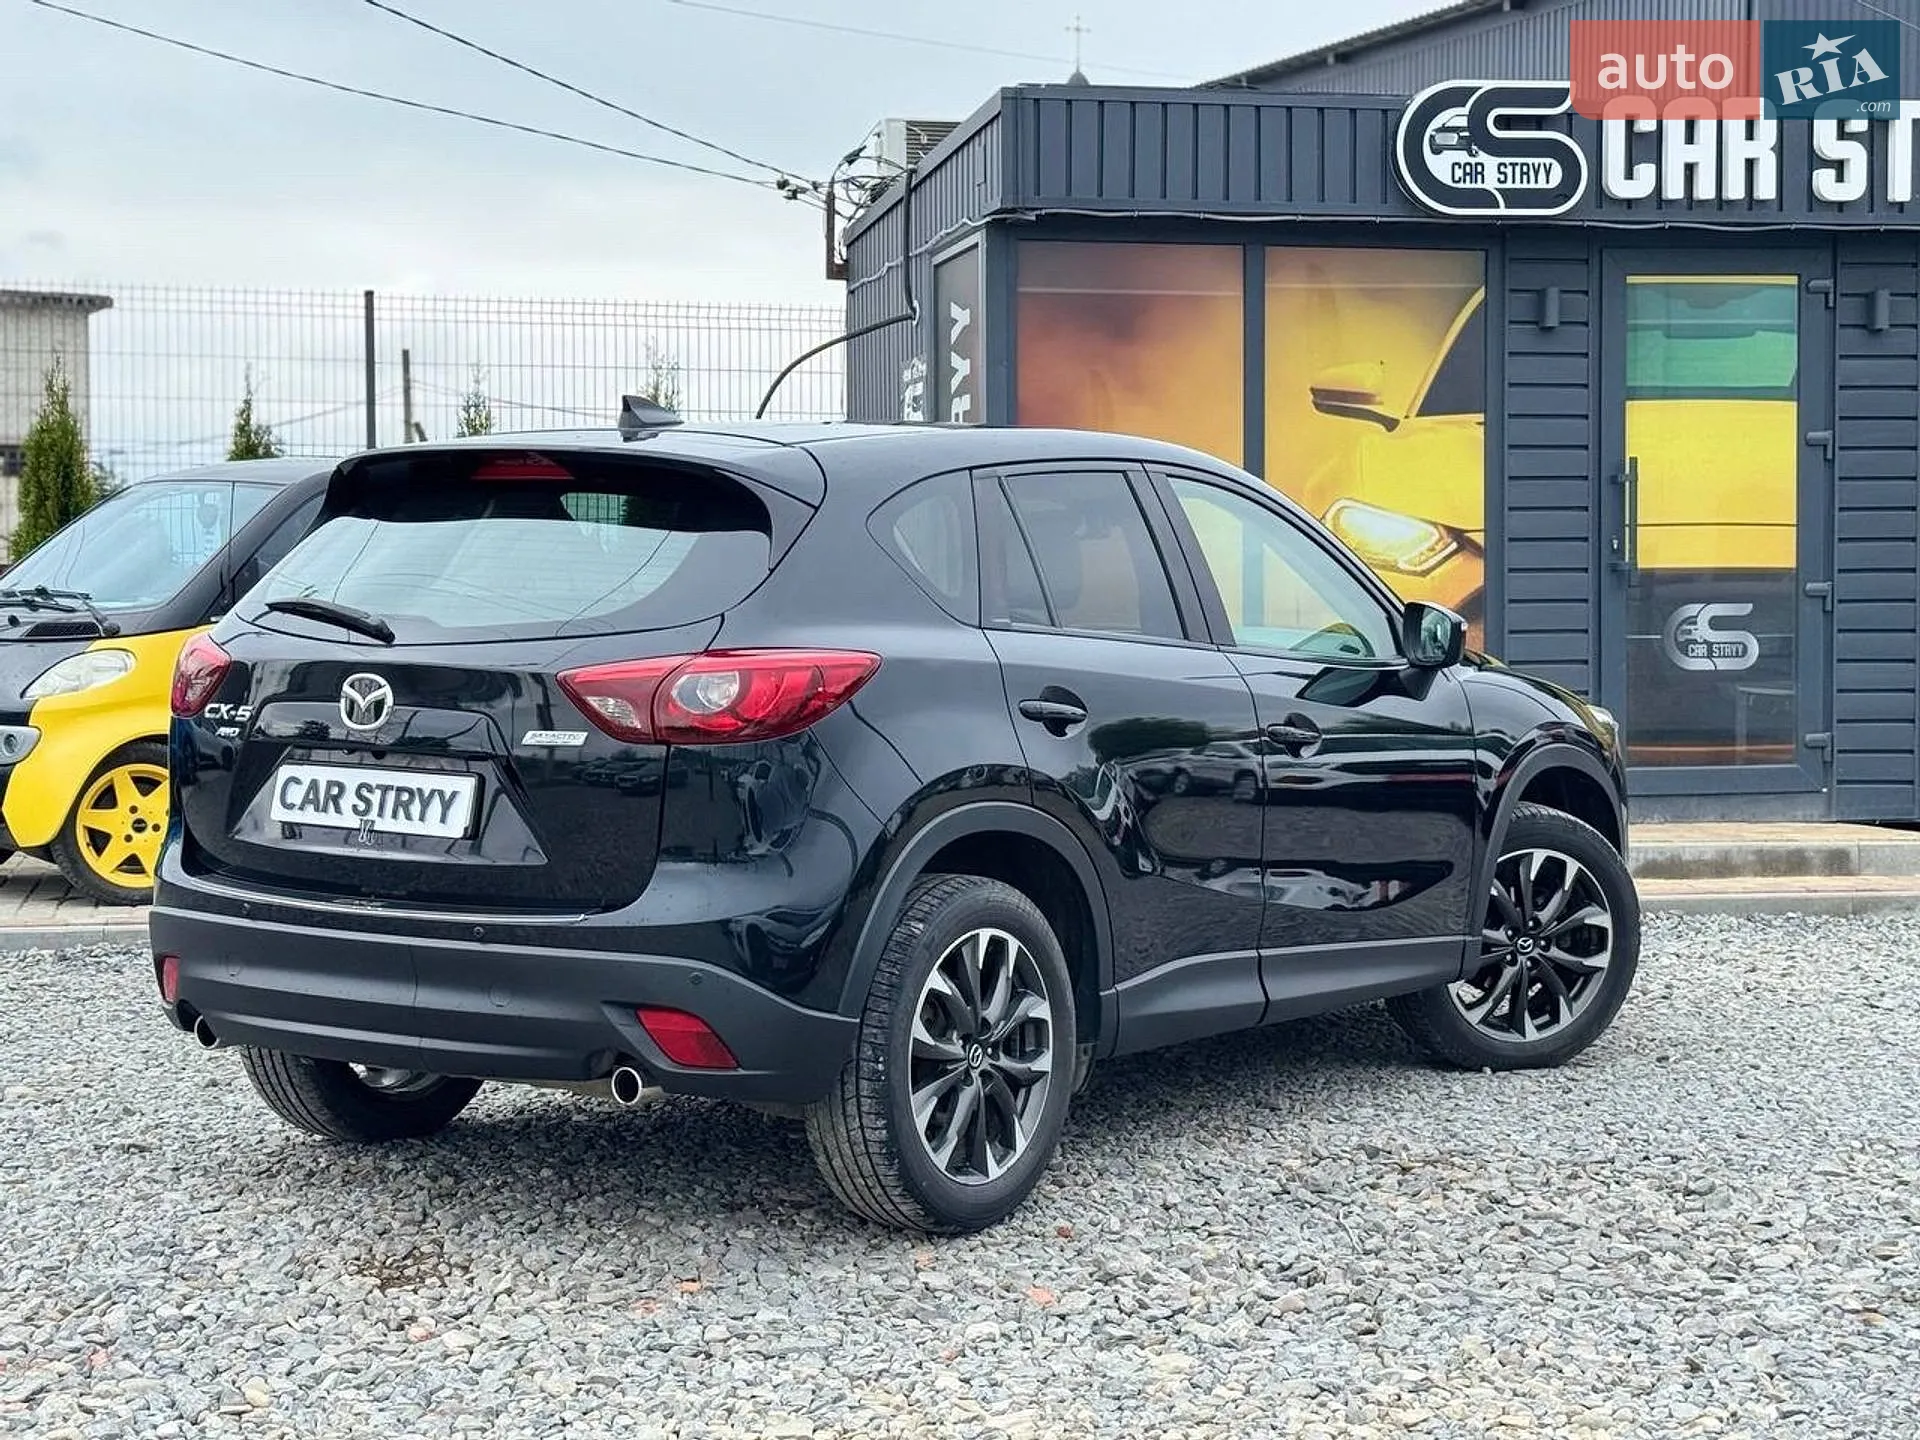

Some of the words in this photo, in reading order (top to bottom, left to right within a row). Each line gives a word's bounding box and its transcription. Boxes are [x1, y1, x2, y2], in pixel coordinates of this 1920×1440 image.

[1602, 95, 1778, 201] CAR
[1451, 162, 1485, 185] CAR
[1497, 162, 1554, 185] STRYY
[1687, 644, 1708, 657] CAR
[1712, 644, 1744, 657] STRYY
[204, 703, 253, 721] CX-5
[279, 775, 346, 816] CAR
[351, 783, 460, 825] STRYY
